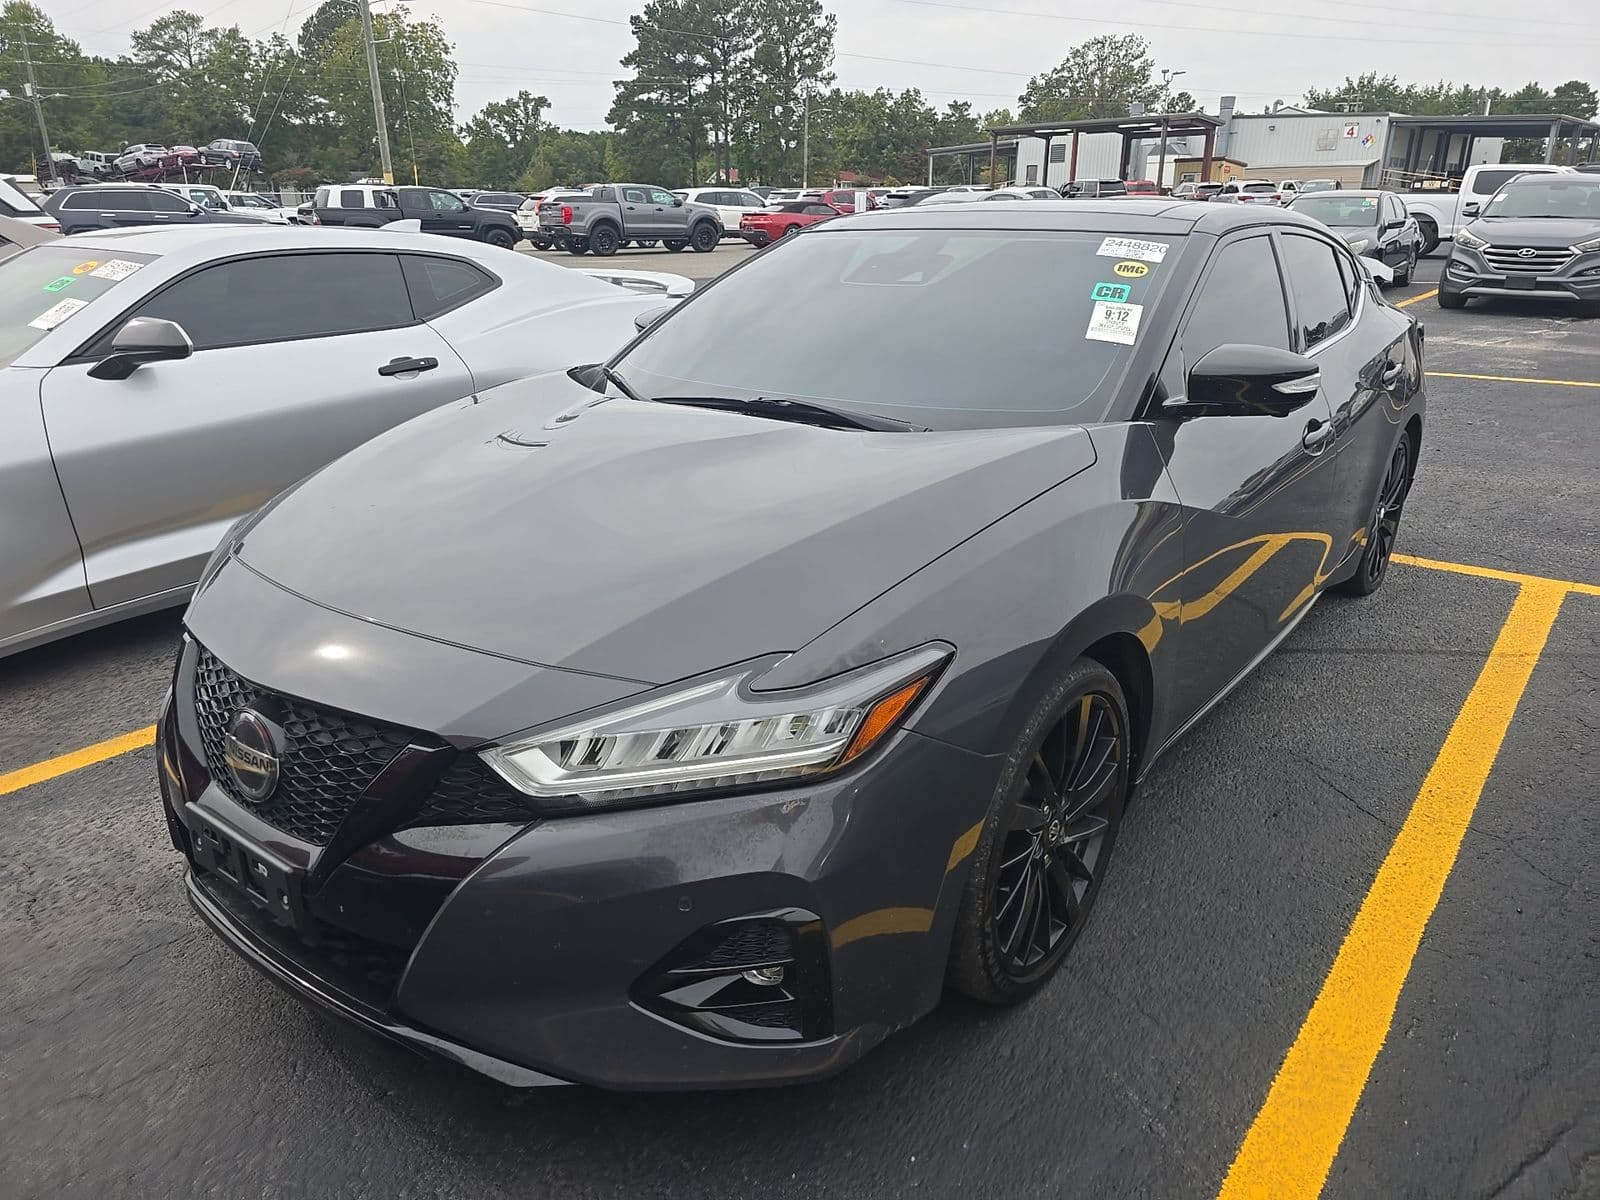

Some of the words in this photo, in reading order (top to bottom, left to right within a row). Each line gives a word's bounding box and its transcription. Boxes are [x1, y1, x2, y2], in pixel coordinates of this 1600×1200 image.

[1346, 127, 1354, 137] 4
[1117, 264, 1145, 275] IMG
[1096, 286, 1126, 299] CR
[1104, 309, 1129, 322] 9:12
[228, 742, 270, 771] NISSAN
